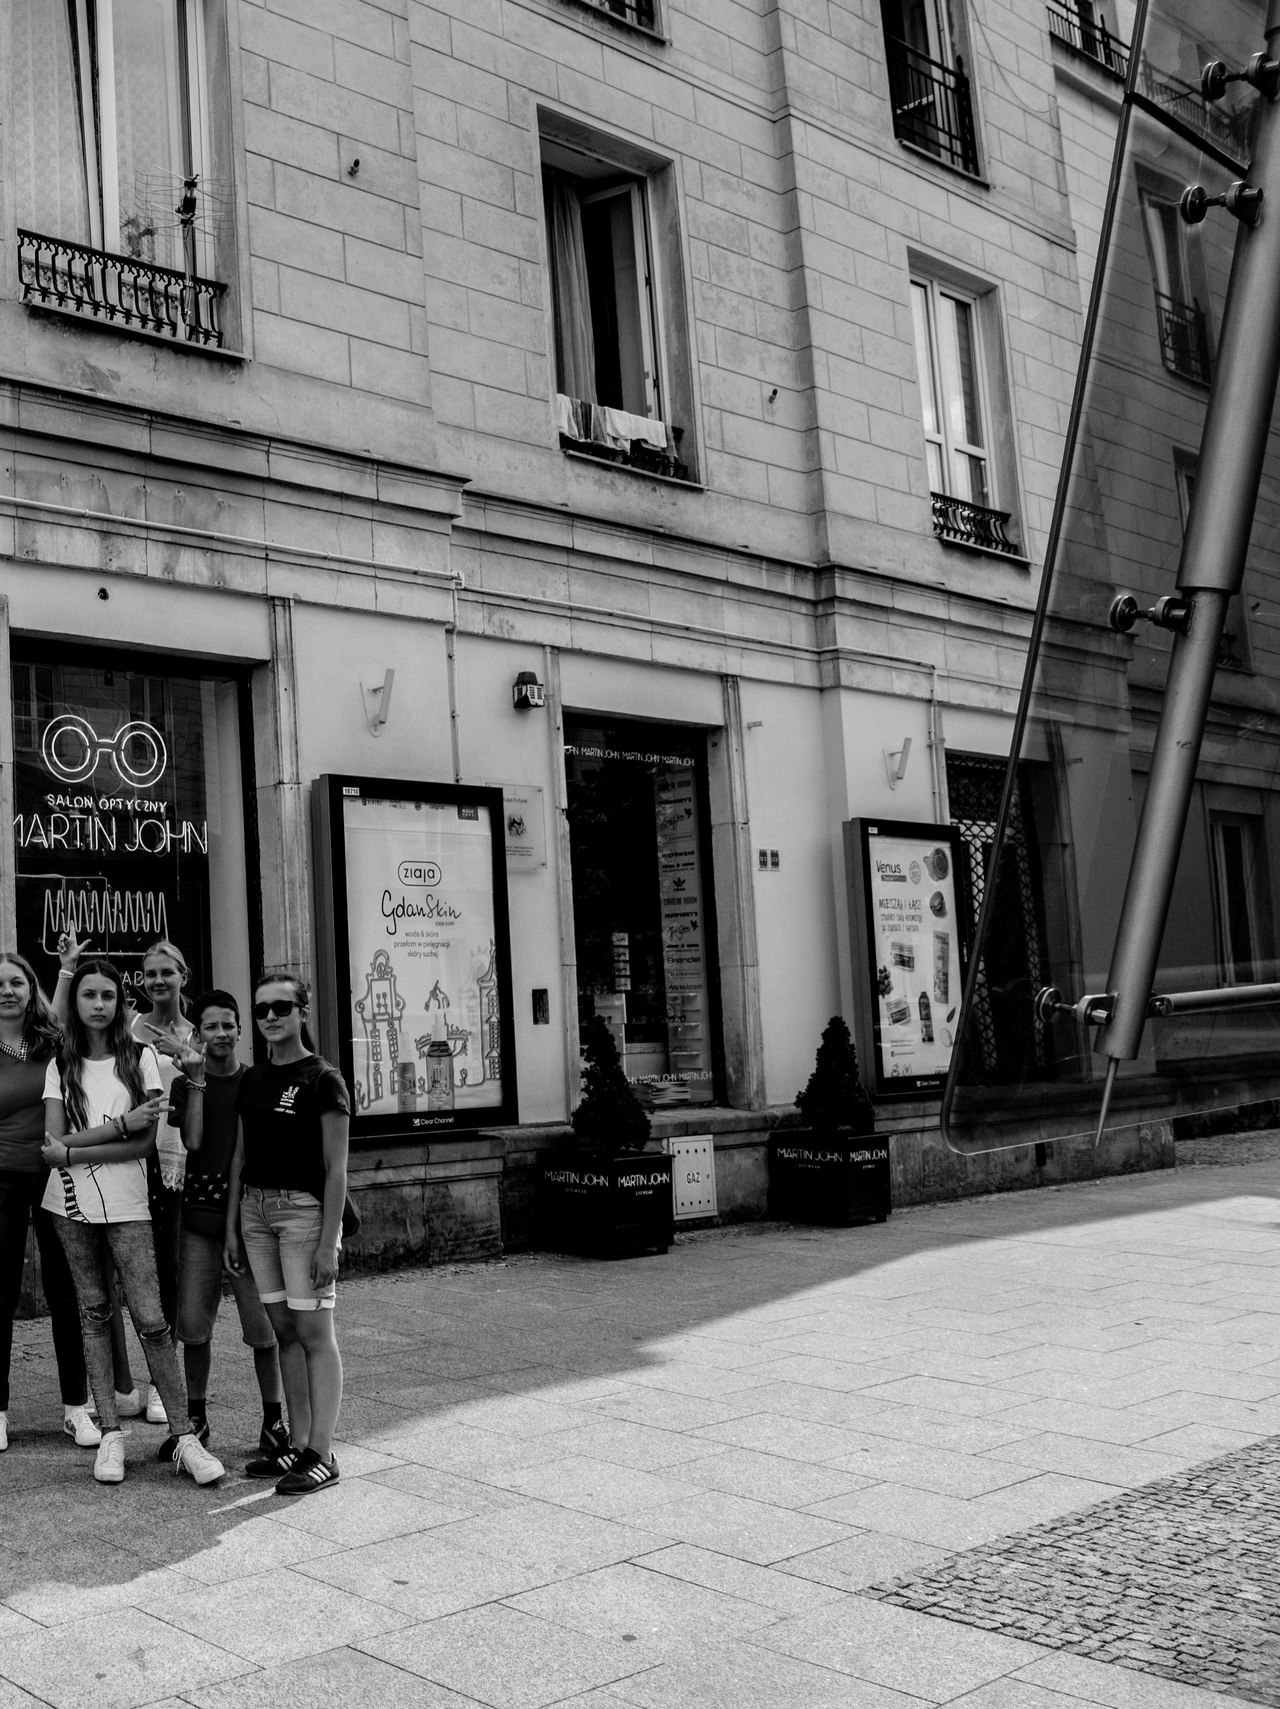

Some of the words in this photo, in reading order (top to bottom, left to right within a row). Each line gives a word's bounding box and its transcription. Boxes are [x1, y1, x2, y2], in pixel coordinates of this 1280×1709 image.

[564, 746, 579, 755] OHN
[581, 747, 603, 757] MARTIN
[603, 749, 620, 759] JOHN
[622, 751, 644, 762] MARTIN
[644, 753, 660, 763] JOHN
[661, 755, 682, 766] MARTIN
[682, 757, 695, 767] JOH
[47, 793, 93, 808] SALON
[99, 798, 168, 812] OPTYCZNY
[125, 818, 208, 854] JOHN
[876, 860, 902, 874] Venus
[403, 867, 436, 883] ziaja
[404, 930, 420, 938] woda
[425, 930, 439, 938] skóra
[393, 940, 417, 949] przełom
[407, 950, 422, 959] skóry
[422, 950, 439, 959] suchej
[666, 956, 701, 964] Brendel
[639, 1073, 660, 1084] MARTIN
[661, 1072, 677, 1083] JOHN
[678, 1071, 700, 1081] MARTIN
[420, 1118, 433, 1126] Clear
[434, 1116, 454, 1124] Channel
[777, 1148, 813, 1160] MARTIN
[814, 1151, 843, 1162] JOHN
[850, 1150, 871, 1162] MARTIN
[871, 1148, 888, 1161] JOHN
[544, 1170, 580, 1184] MARTIN
[581, 1173, 609, 1187] JOHN
[618, 1174, 648, 1188] MARTIN
[648, 1172, 670, 1186] JOHN
[686, 1171, 701, 1185] GAZ
